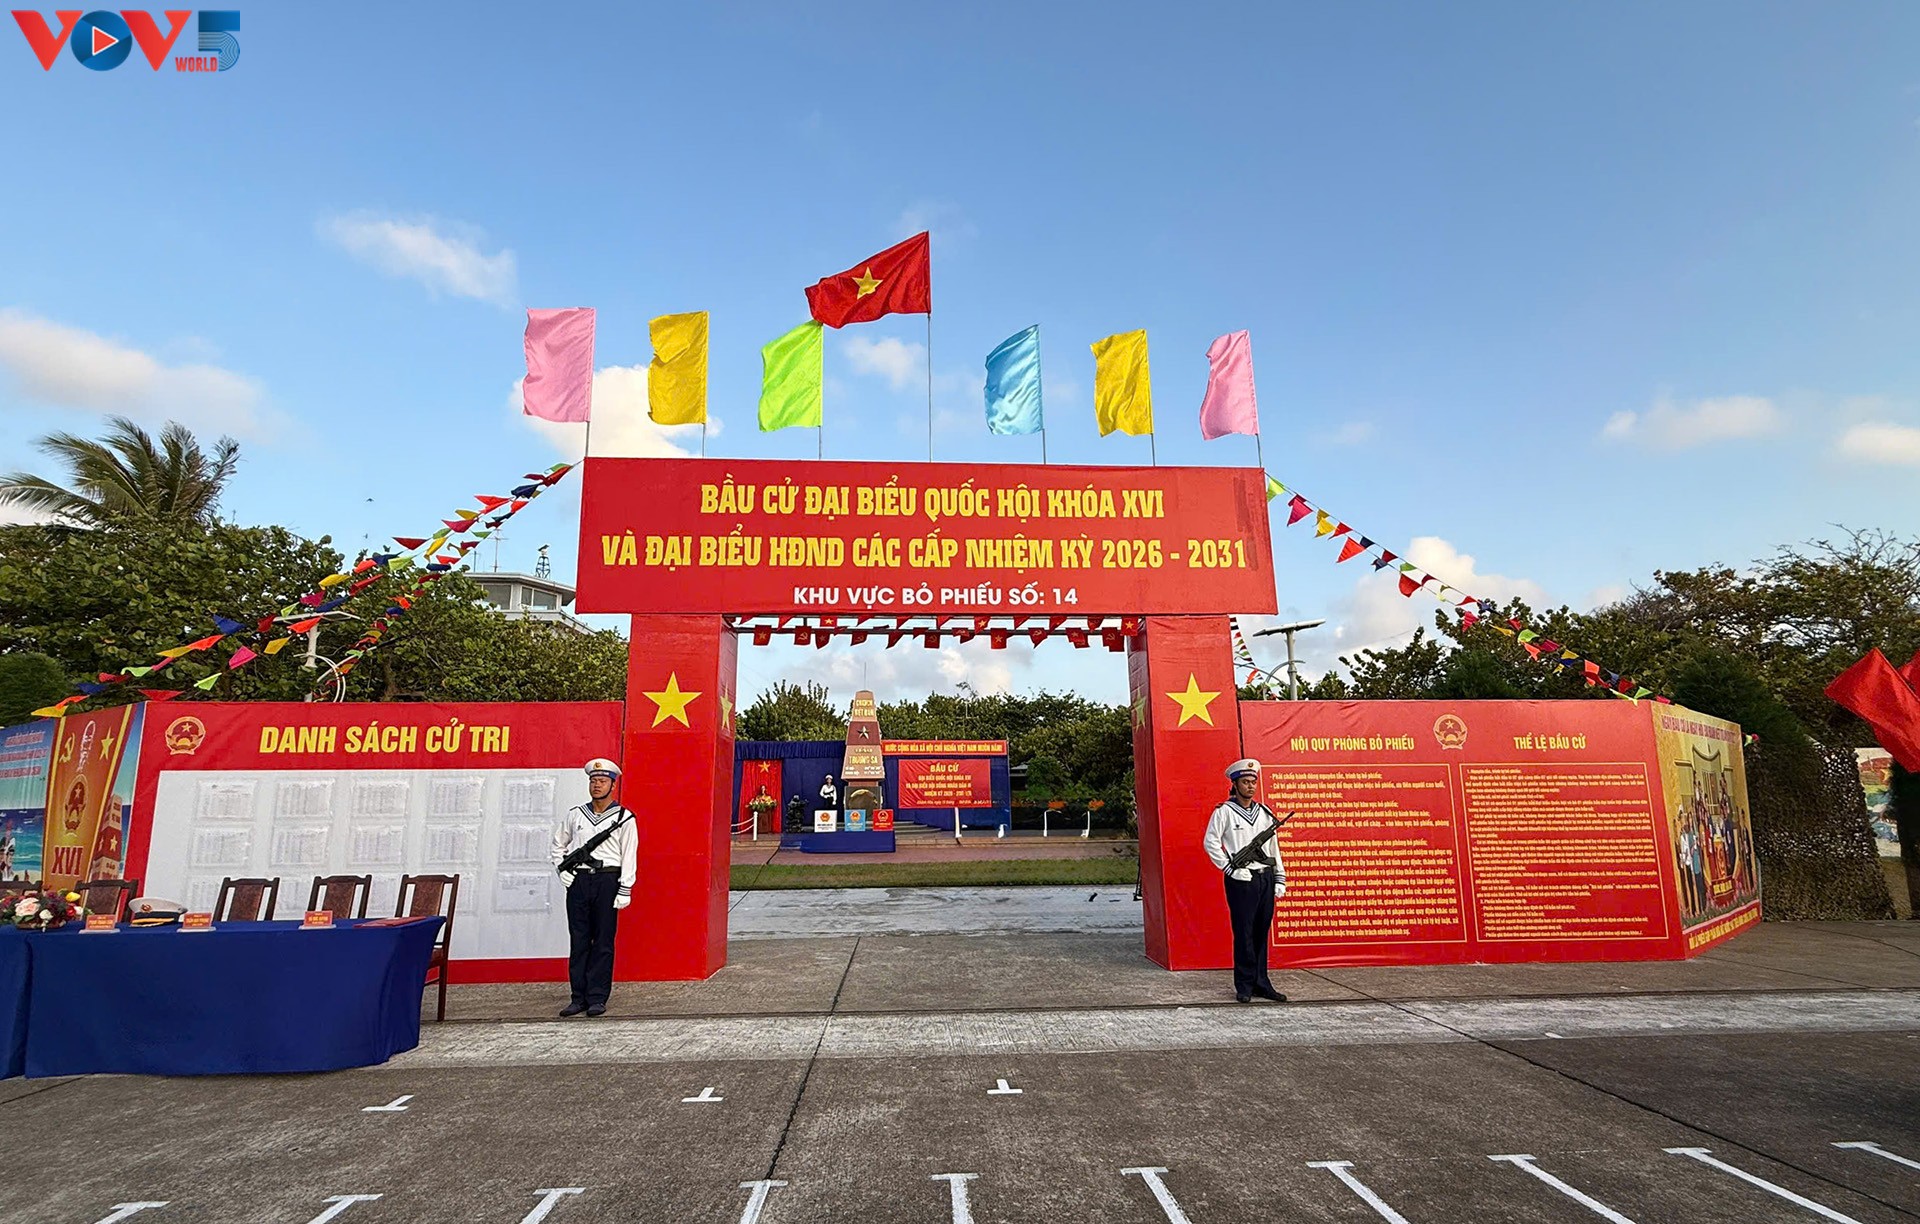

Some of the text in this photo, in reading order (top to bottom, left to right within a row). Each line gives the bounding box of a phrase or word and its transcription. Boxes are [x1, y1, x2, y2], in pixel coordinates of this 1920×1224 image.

[700, 473, 1164, 523] BẦU CỬ ĐẠI BIỂU QUỐC HỘI KHÓA XVI
[601, 529, 637, 565] VÀ
[645, 536, 692, 571] ĐẠI
[699, 528, 762, 565] BIỂU
[769, 536, 844, 566] HĐND
[852, 532, 900, 567] CÁC
[908, 529, 958, 567] CẤP
[965, 533, 1054, 573] NHIỆM
[1060, 533, 1094, 568] KỲ
[1102, 539, 1163, 568] 2026
[1187, 539, 1247, 568] 2031
[794, 583, 1078, 609] KHU VỰC BỎ PHIẾU SỐ: 14
[259, 717, 509, 753] DANH SÁCH CỬ TRI
[1290, 733, 1414, 753] NỘI QUY PHÒNG BỎ PHIẾU
[1513, 732, 1586, 752] THỂ LỆ BẦU CỬ
[52, 846, 83, 876] XVI
